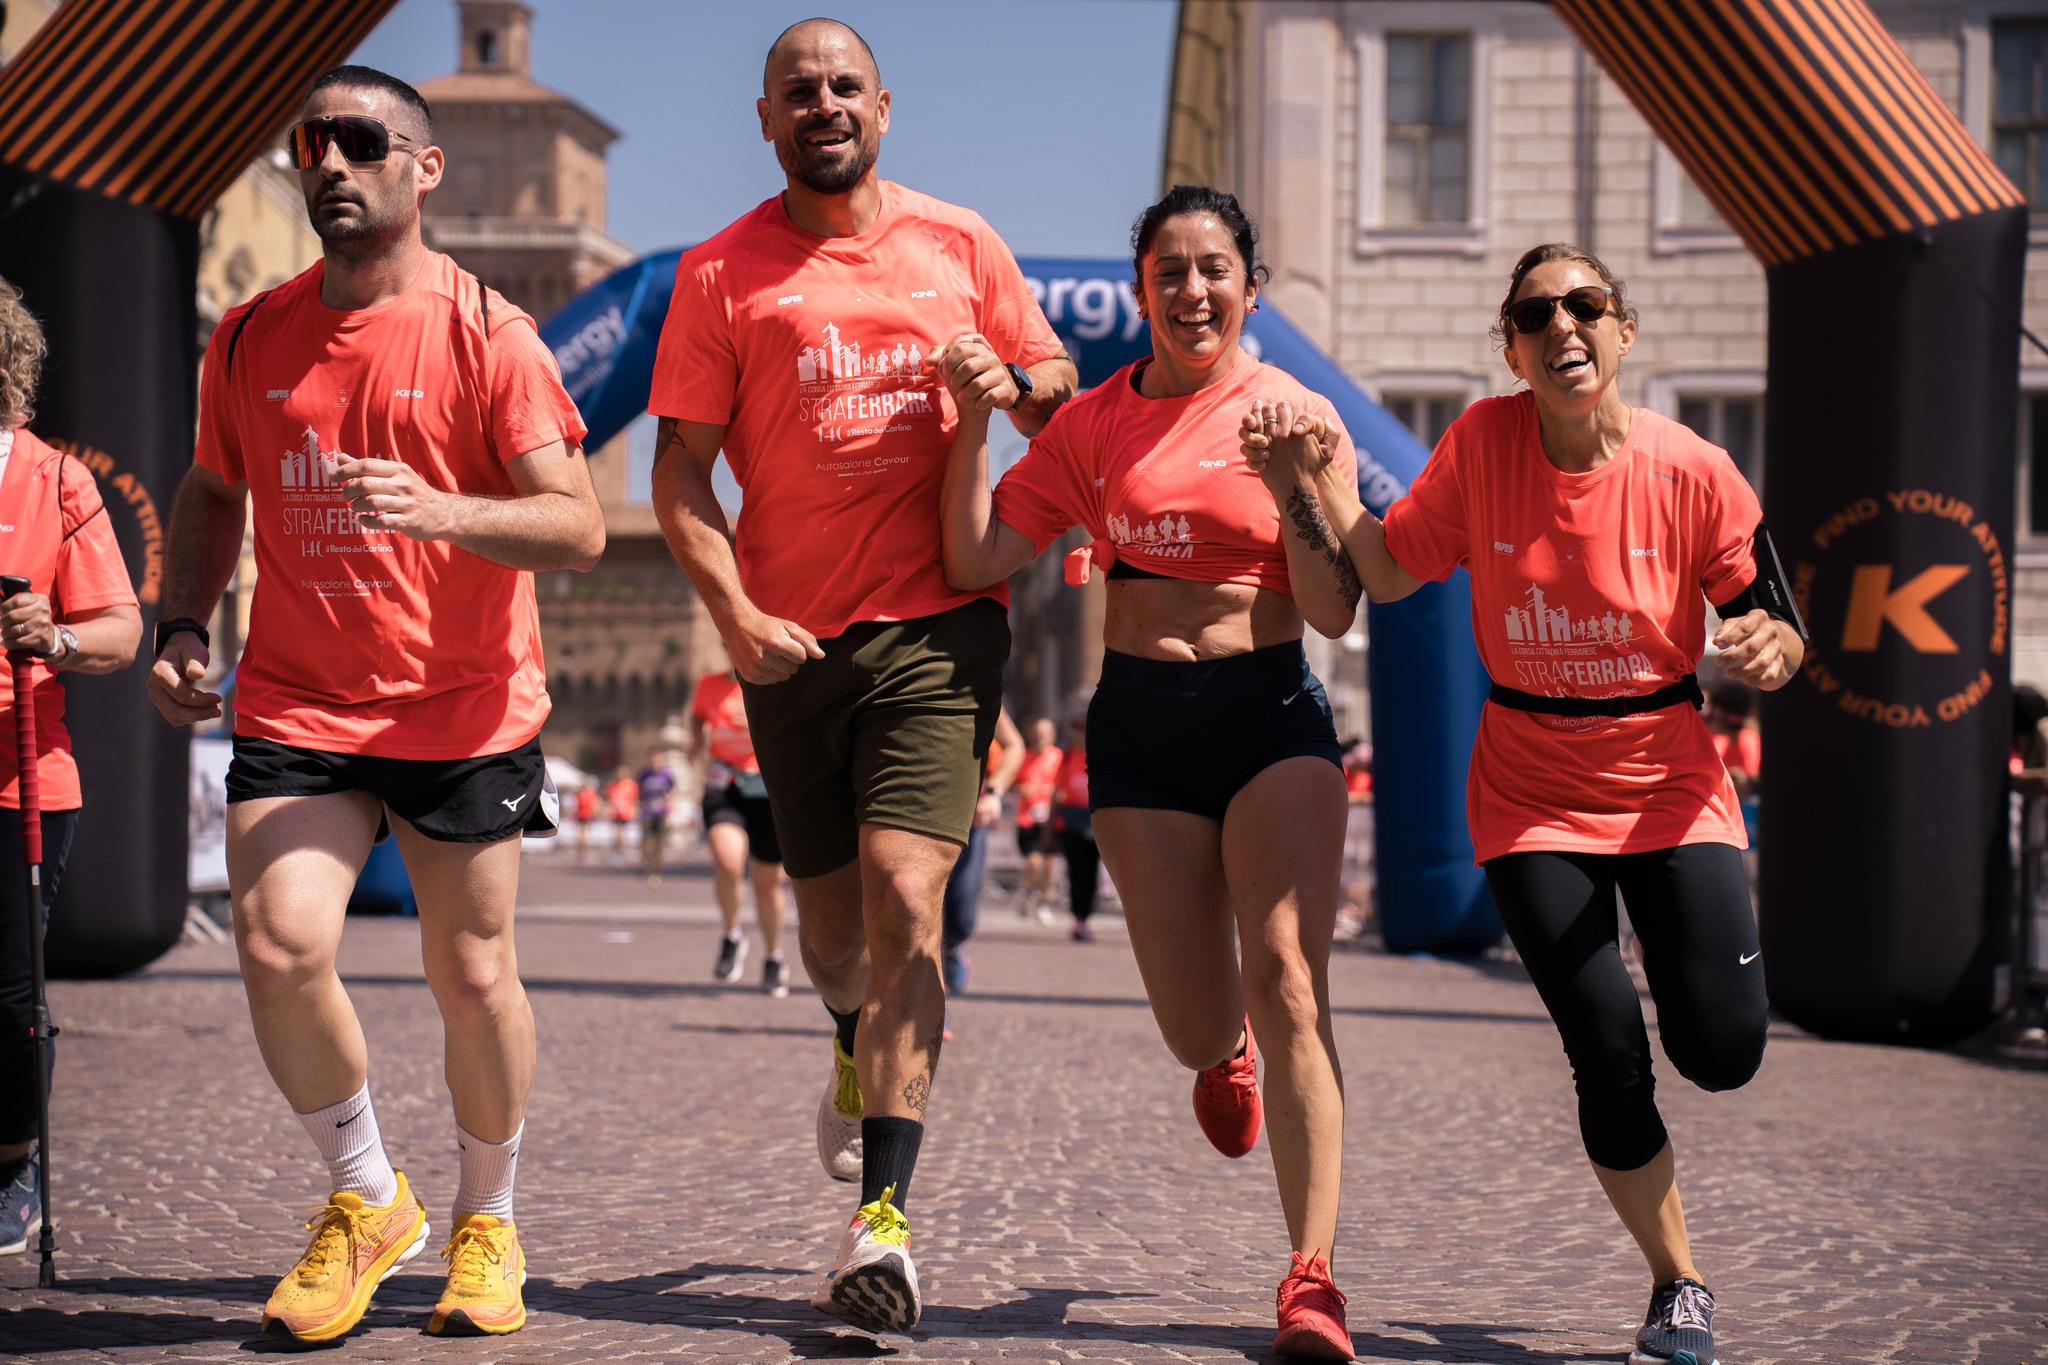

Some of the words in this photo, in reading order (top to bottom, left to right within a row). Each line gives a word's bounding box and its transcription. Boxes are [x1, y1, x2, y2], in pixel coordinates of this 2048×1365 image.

[912, 290, 937, 299] KING
[395, 389, 424, 399] KING
[808, 385, 826, 393] CORSA
[799, 390, 933, 422] STRAFERRARA
[851, 428, 872, 437] Resto
[884, 424, 912, 433] Carlino
[815, 458, 872, 471] Autosalone
[874, 456, 910, 467] Cavour
[1199, 460, 1227, 468] KING
[289, 494, 303, 502] CORSA
[1812, 498, 1879, 550] FIND
[1887, 490, 1975, 528] YOUR
[330, 545, 352, 553] Resto
[352, 545, 362, 553] del
[362, 543, 394, 553] Carlino
[1630, 548, 1658, 557] KING
[301, 579, 352, 589] Autosalone
[354, 579, 394, 589] Cavour
[1842, 564, 1972, 654] K
[1518, 647, 1535, 655] CORSA
[1564, 647, 1597, 656] FERRARESE
[1515, 651, 1654, 686] STRAFERRARA
[1936, 668, 1993, 721] FIND
[1838, 691, 1931, 727] YOUR
